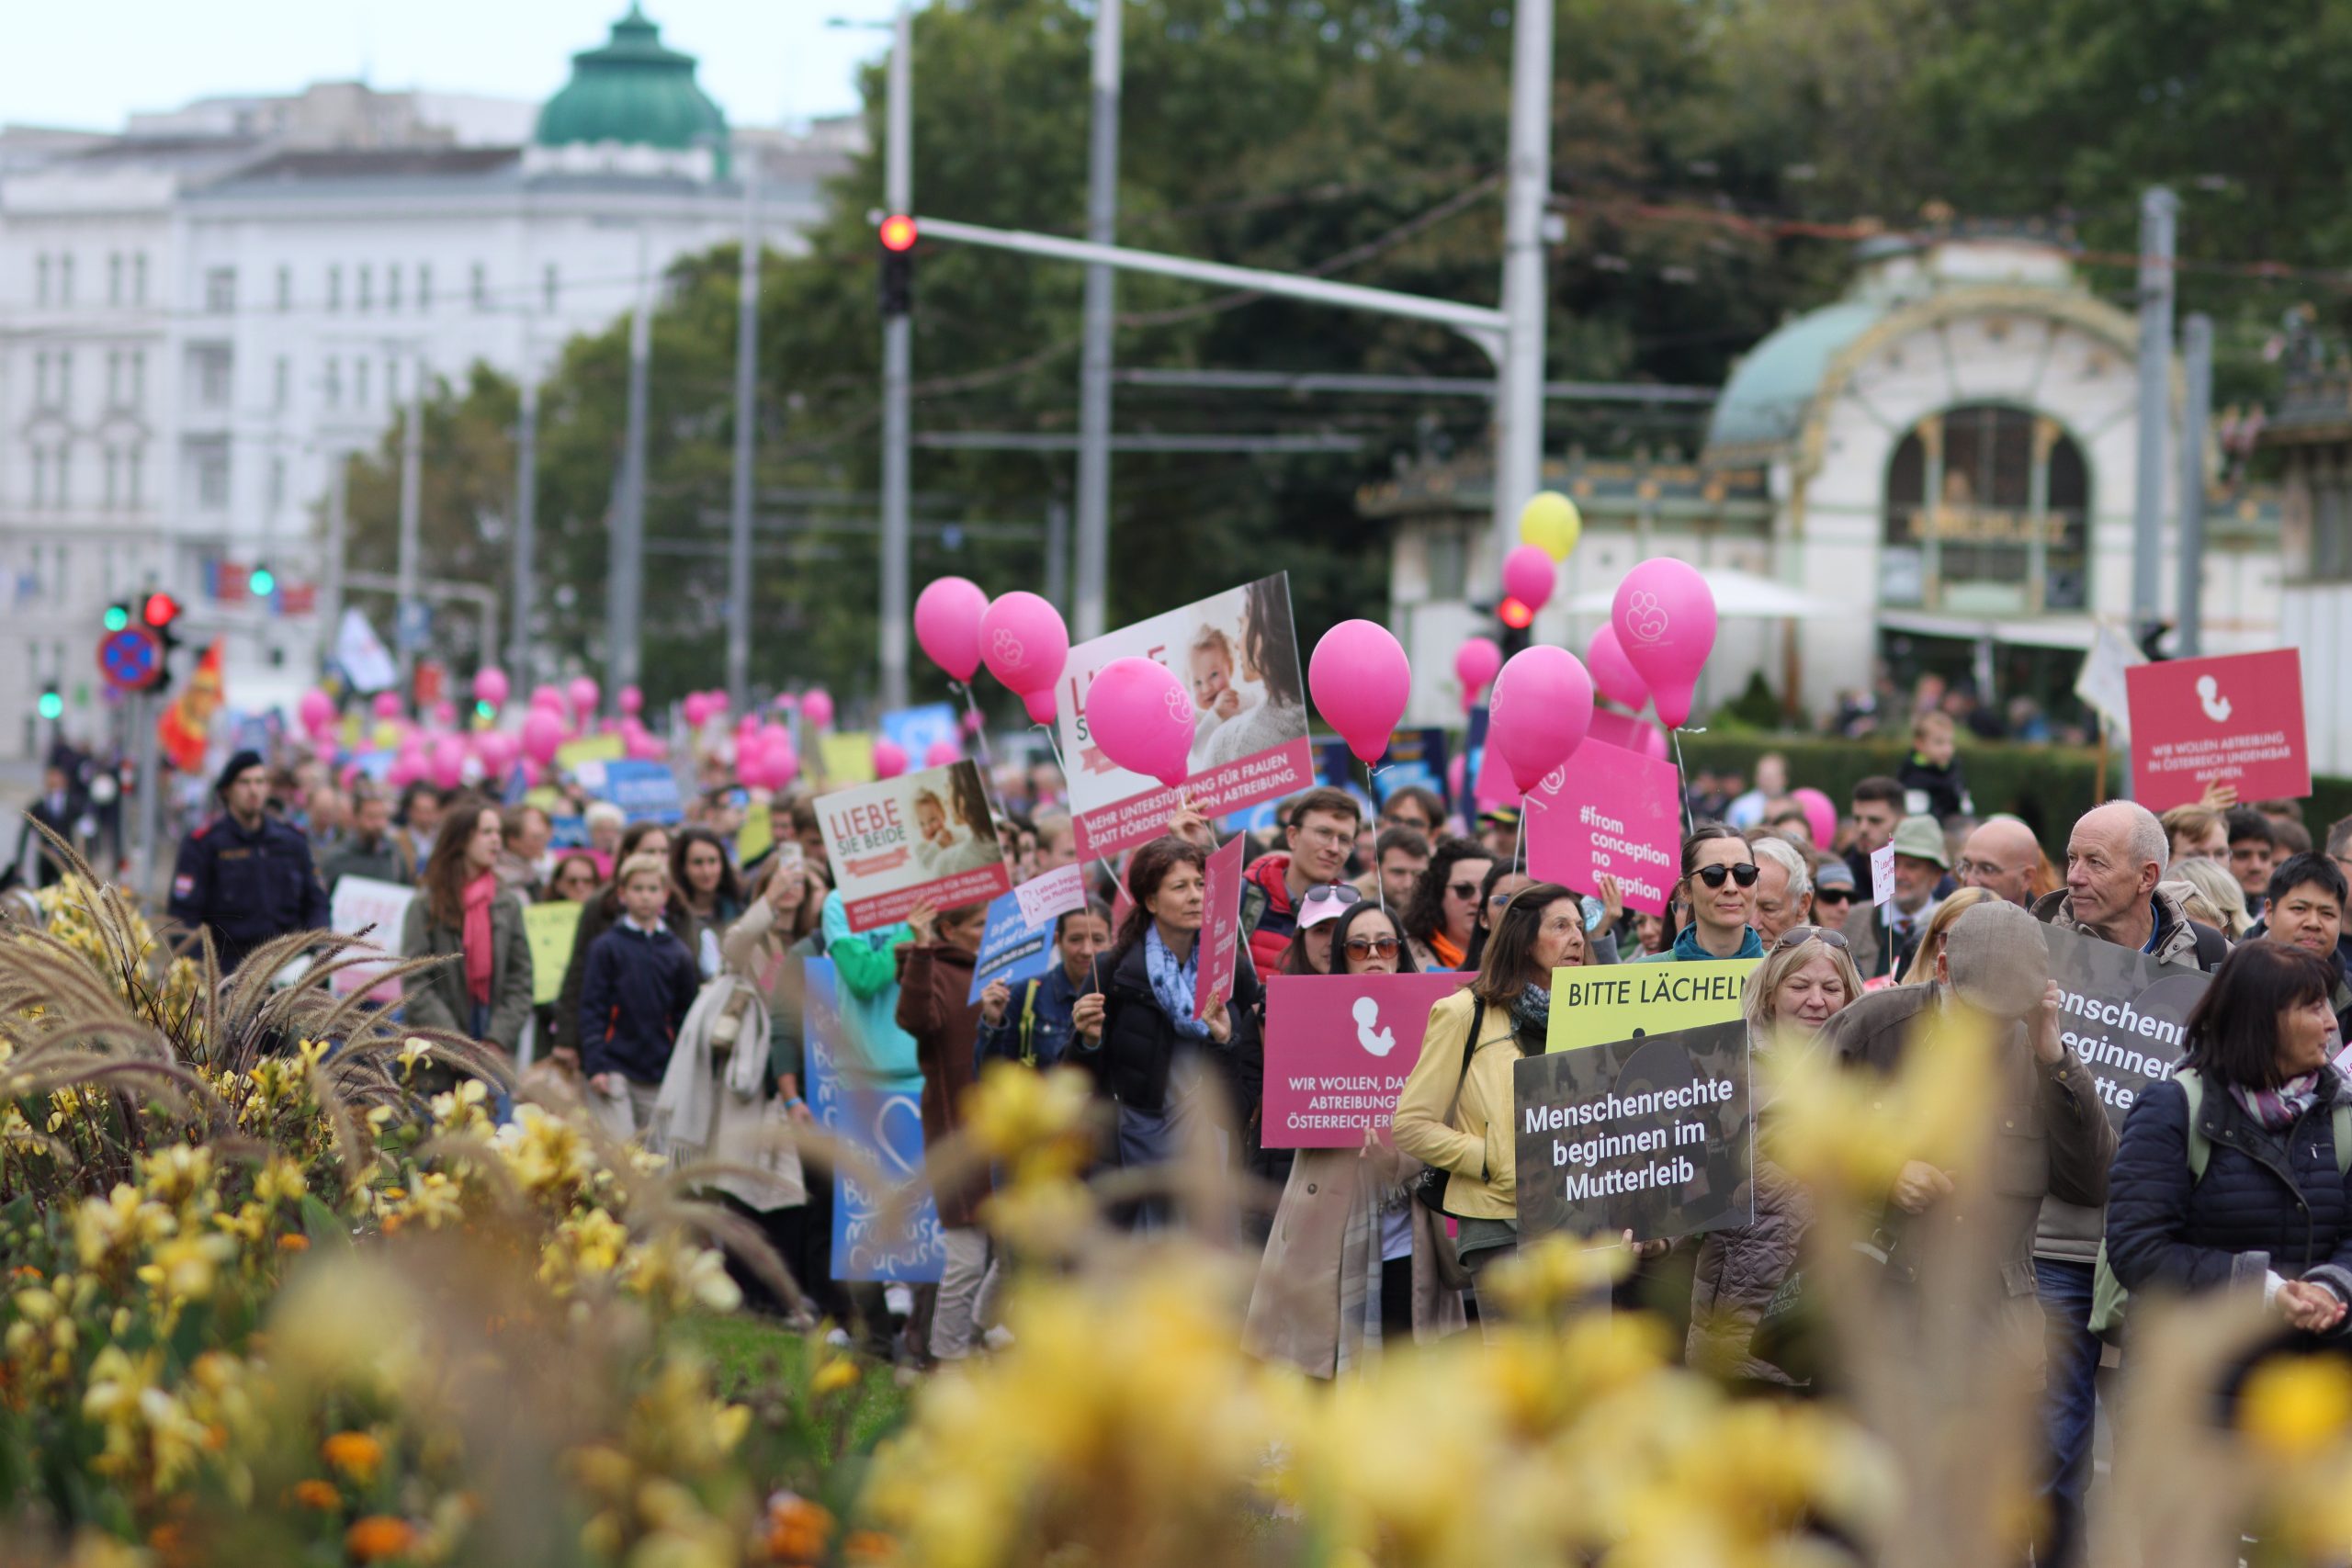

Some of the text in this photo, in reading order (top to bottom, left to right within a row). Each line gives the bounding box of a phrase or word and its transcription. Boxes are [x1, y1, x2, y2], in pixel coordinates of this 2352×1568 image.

[1087, 810, 1122, 832] MEHR
[1218, 768, 1240, 788] FÜR
[1242, 752, 1288, 780] FRAUEN
[1088, 829, 1120, 850] STATT
[1121, 808, 1178, 838] FÖRDERUN
[1224, 769, 1298, 804] ABTREIBUNG.
[830, 797, 902, 840] LIEBE
[1580, 805, 1624, 835] #from
[837, 826, 908, 856] SIE BEIDE
[1590, 831, 1670, 868] conception
[1591, 850, 1611, 868] no
[1568, 980, 1632, 1007] BITTE
[1288, 1077, 1317, 1091] WIR
[1319, 1076, 1382, 1093] WOLLEN,
[1286, 1111, 1370, 1129] ÖSTERREICH
[1525, 1077, 1733, 1134] Menschenrechte
[1553, 1127, 1667, 1168] beginnen
[1674, 1119, 1705, 1146] im
[1566, 1155, 1694, 1201] Mutterleib
